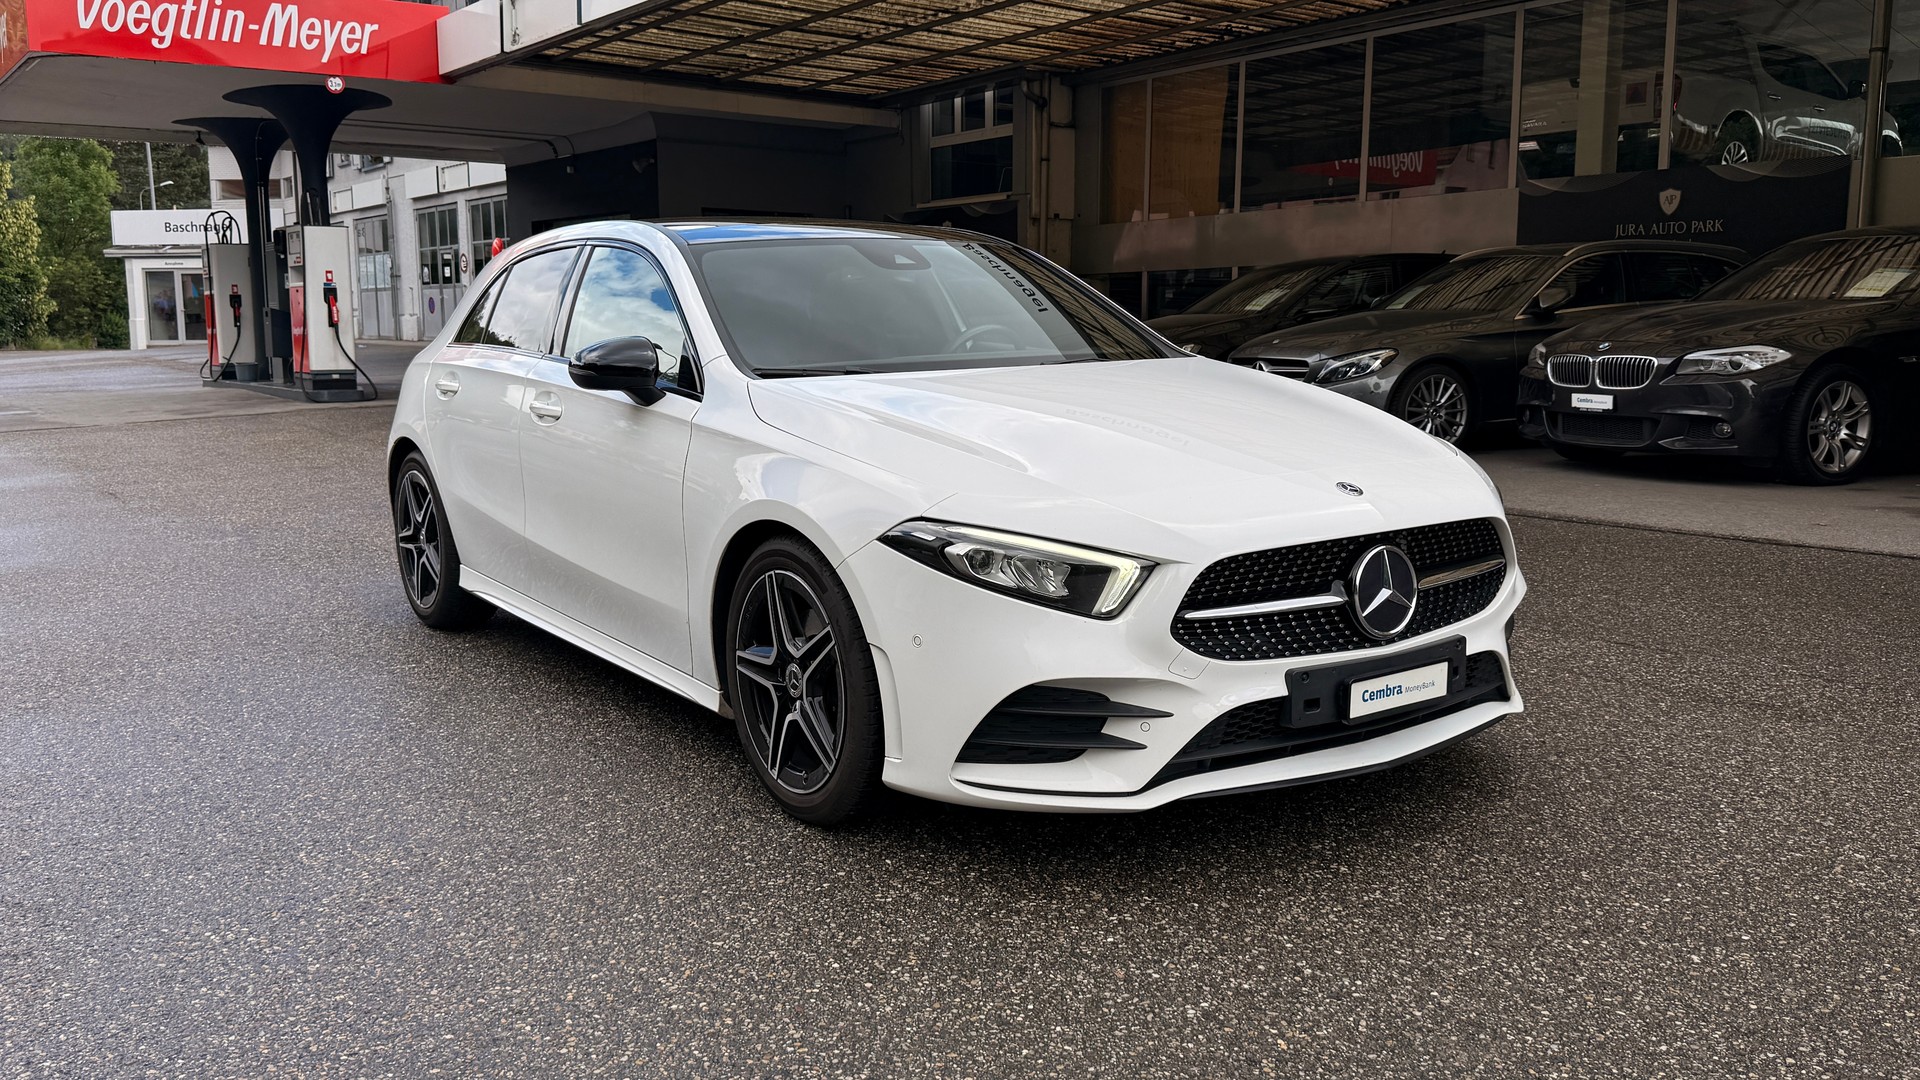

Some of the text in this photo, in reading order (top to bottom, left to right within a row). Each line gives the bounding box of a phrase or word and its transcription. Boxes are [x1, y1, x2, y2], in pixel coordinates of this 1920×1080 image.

[76, 0, 379, 63] Voegtlin-Meyer
[1615, 219, 1724, 239] JURA AUTO PARK
[1362, 681, 1436, 703] Cembra MoneyBank
